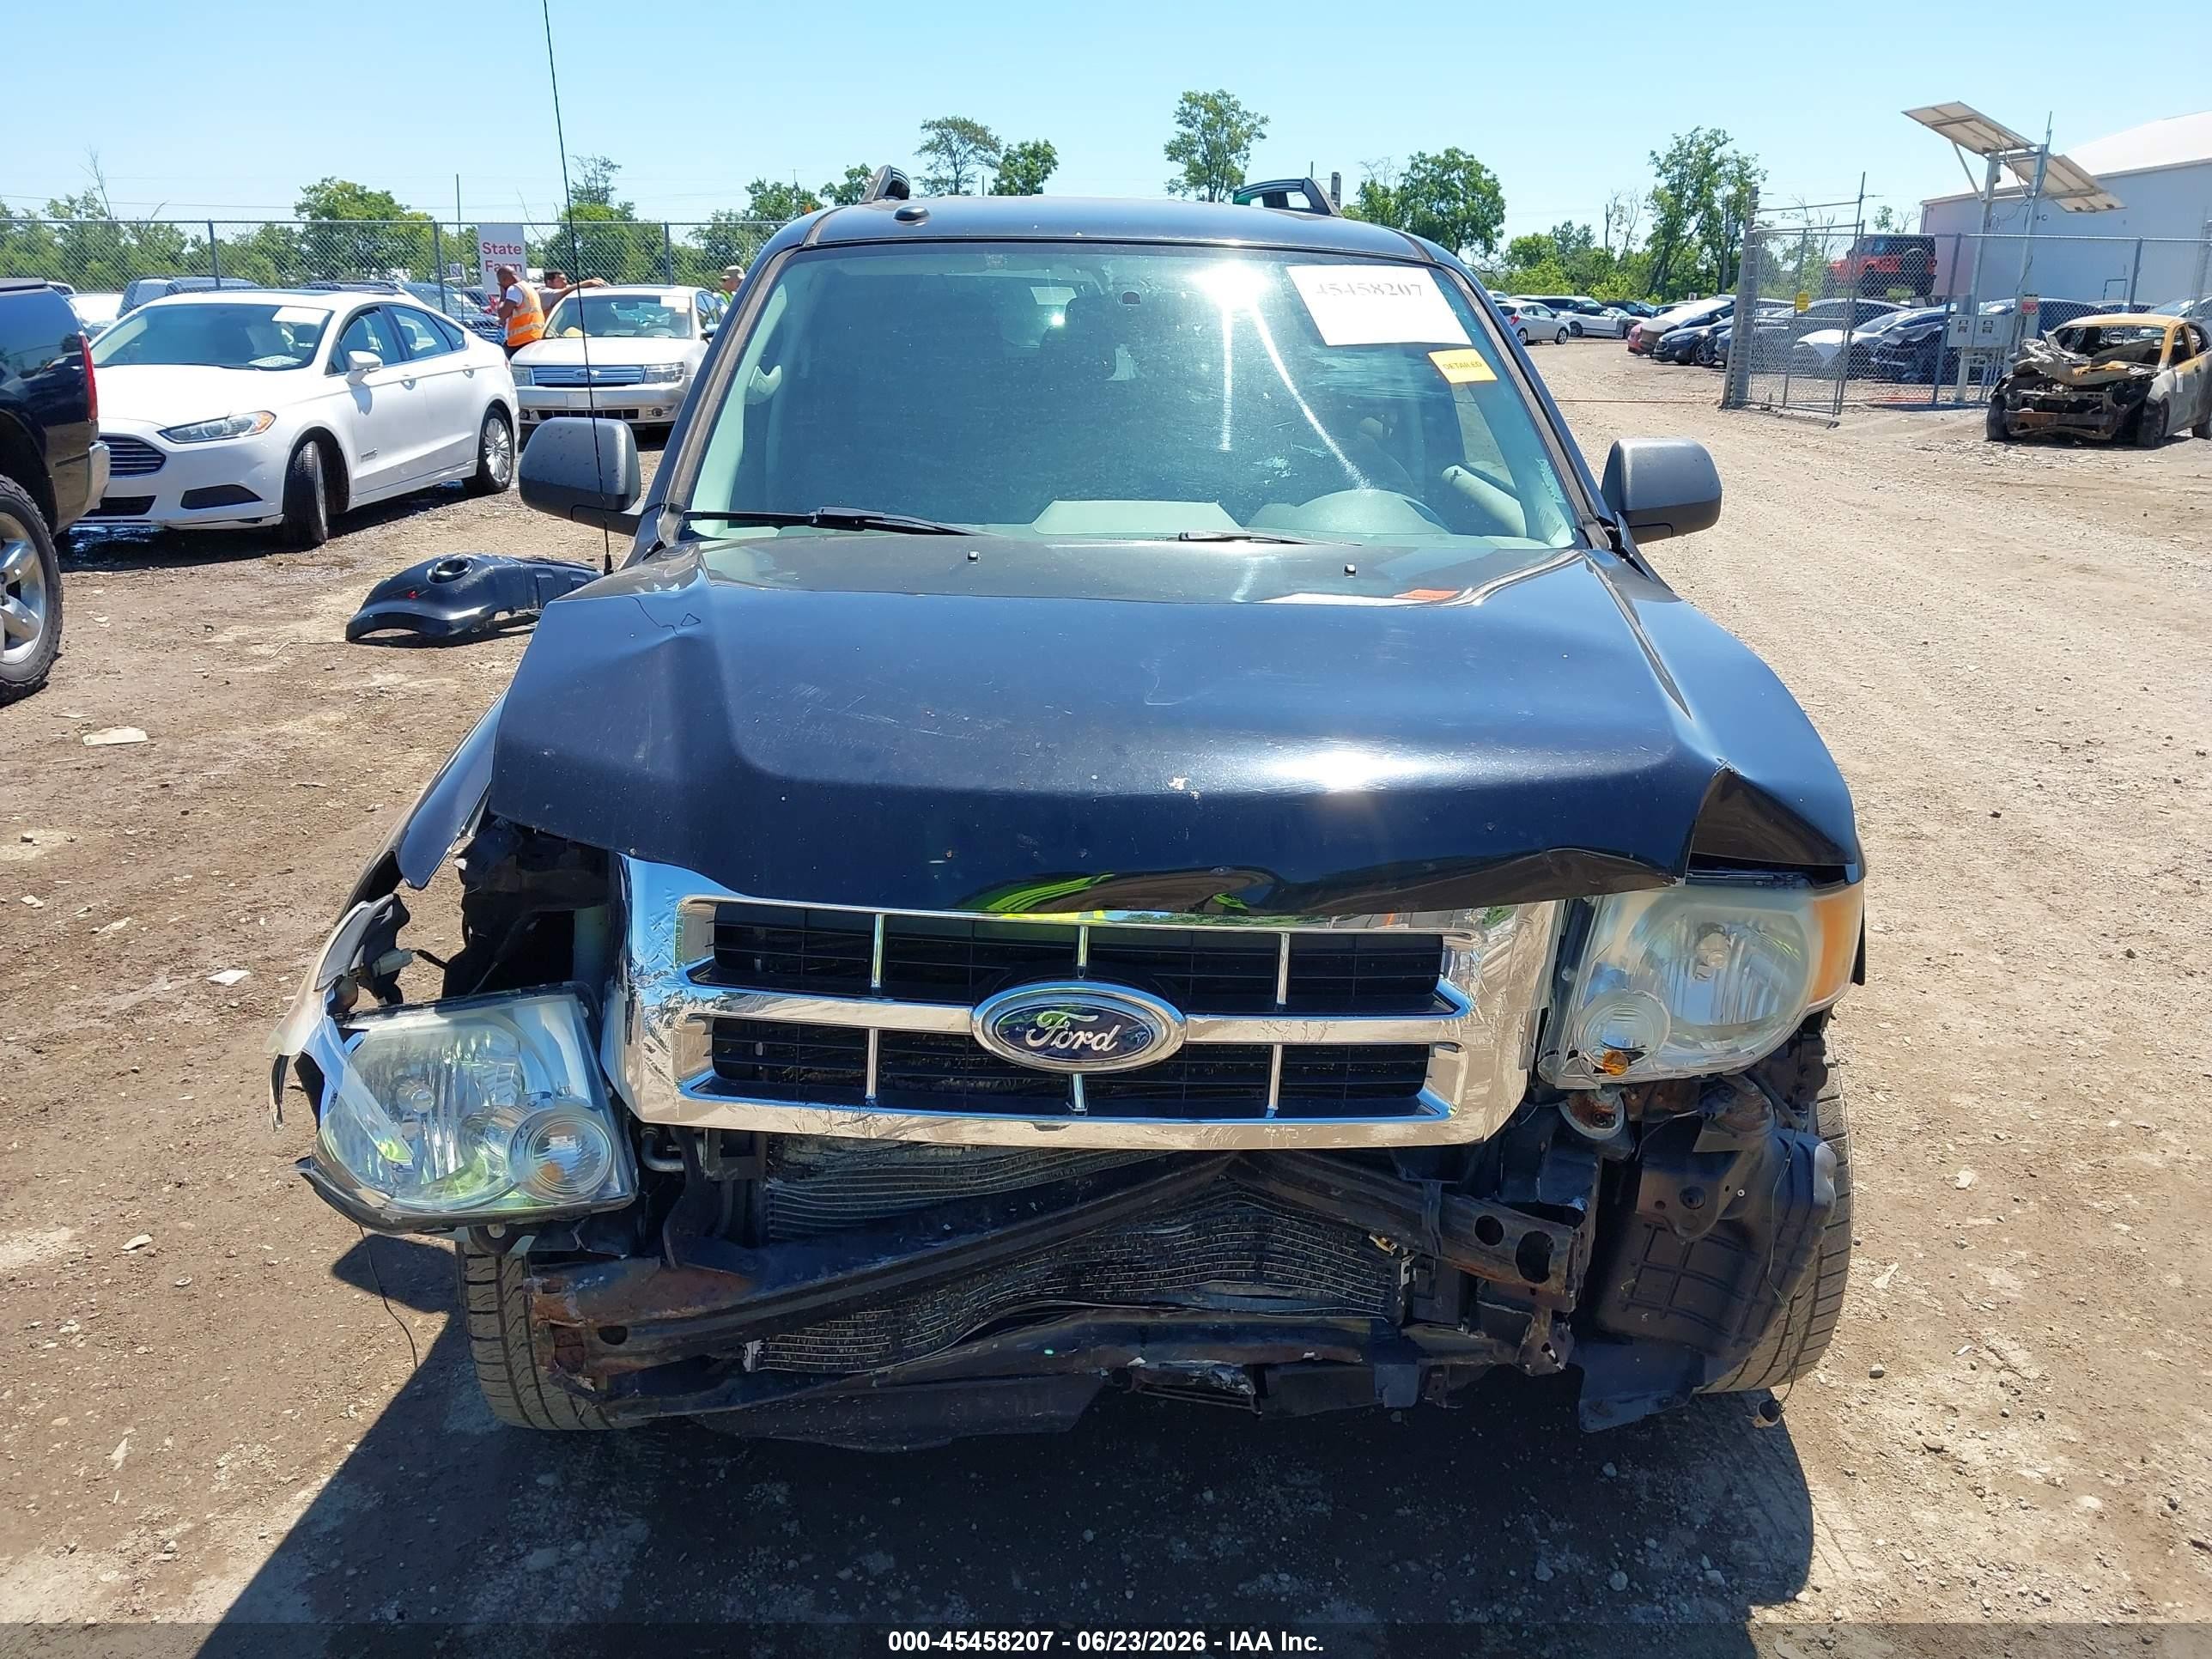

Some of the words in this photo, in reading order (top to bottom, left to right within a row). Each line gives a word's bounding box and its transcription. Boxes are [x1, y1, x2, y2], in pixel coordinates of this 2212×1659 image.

[482, 241, 522, 255] State
[484, 260, 523, 273] Fam
[1442, 361, 1483, 370] DETAILED
[1025, 1010, 1121, 1052] Ford
